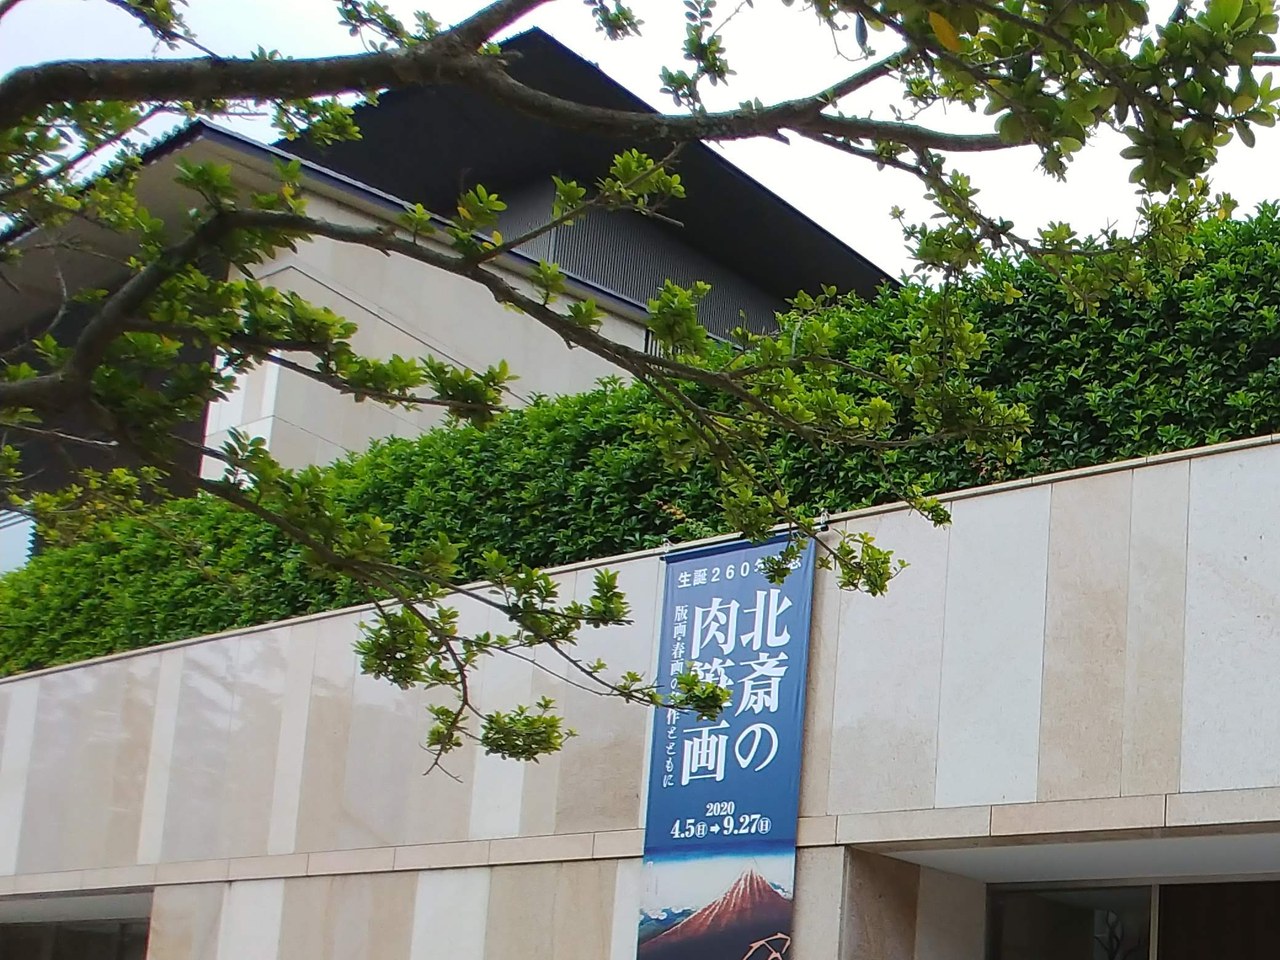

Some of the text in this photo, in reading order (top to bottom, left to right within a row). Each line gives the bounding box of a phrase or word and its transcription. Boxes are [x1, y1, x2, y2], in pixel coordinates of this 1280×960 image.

[735, 588, 793, 773] 北斎の
[705, 801, 735, 817] 2020
